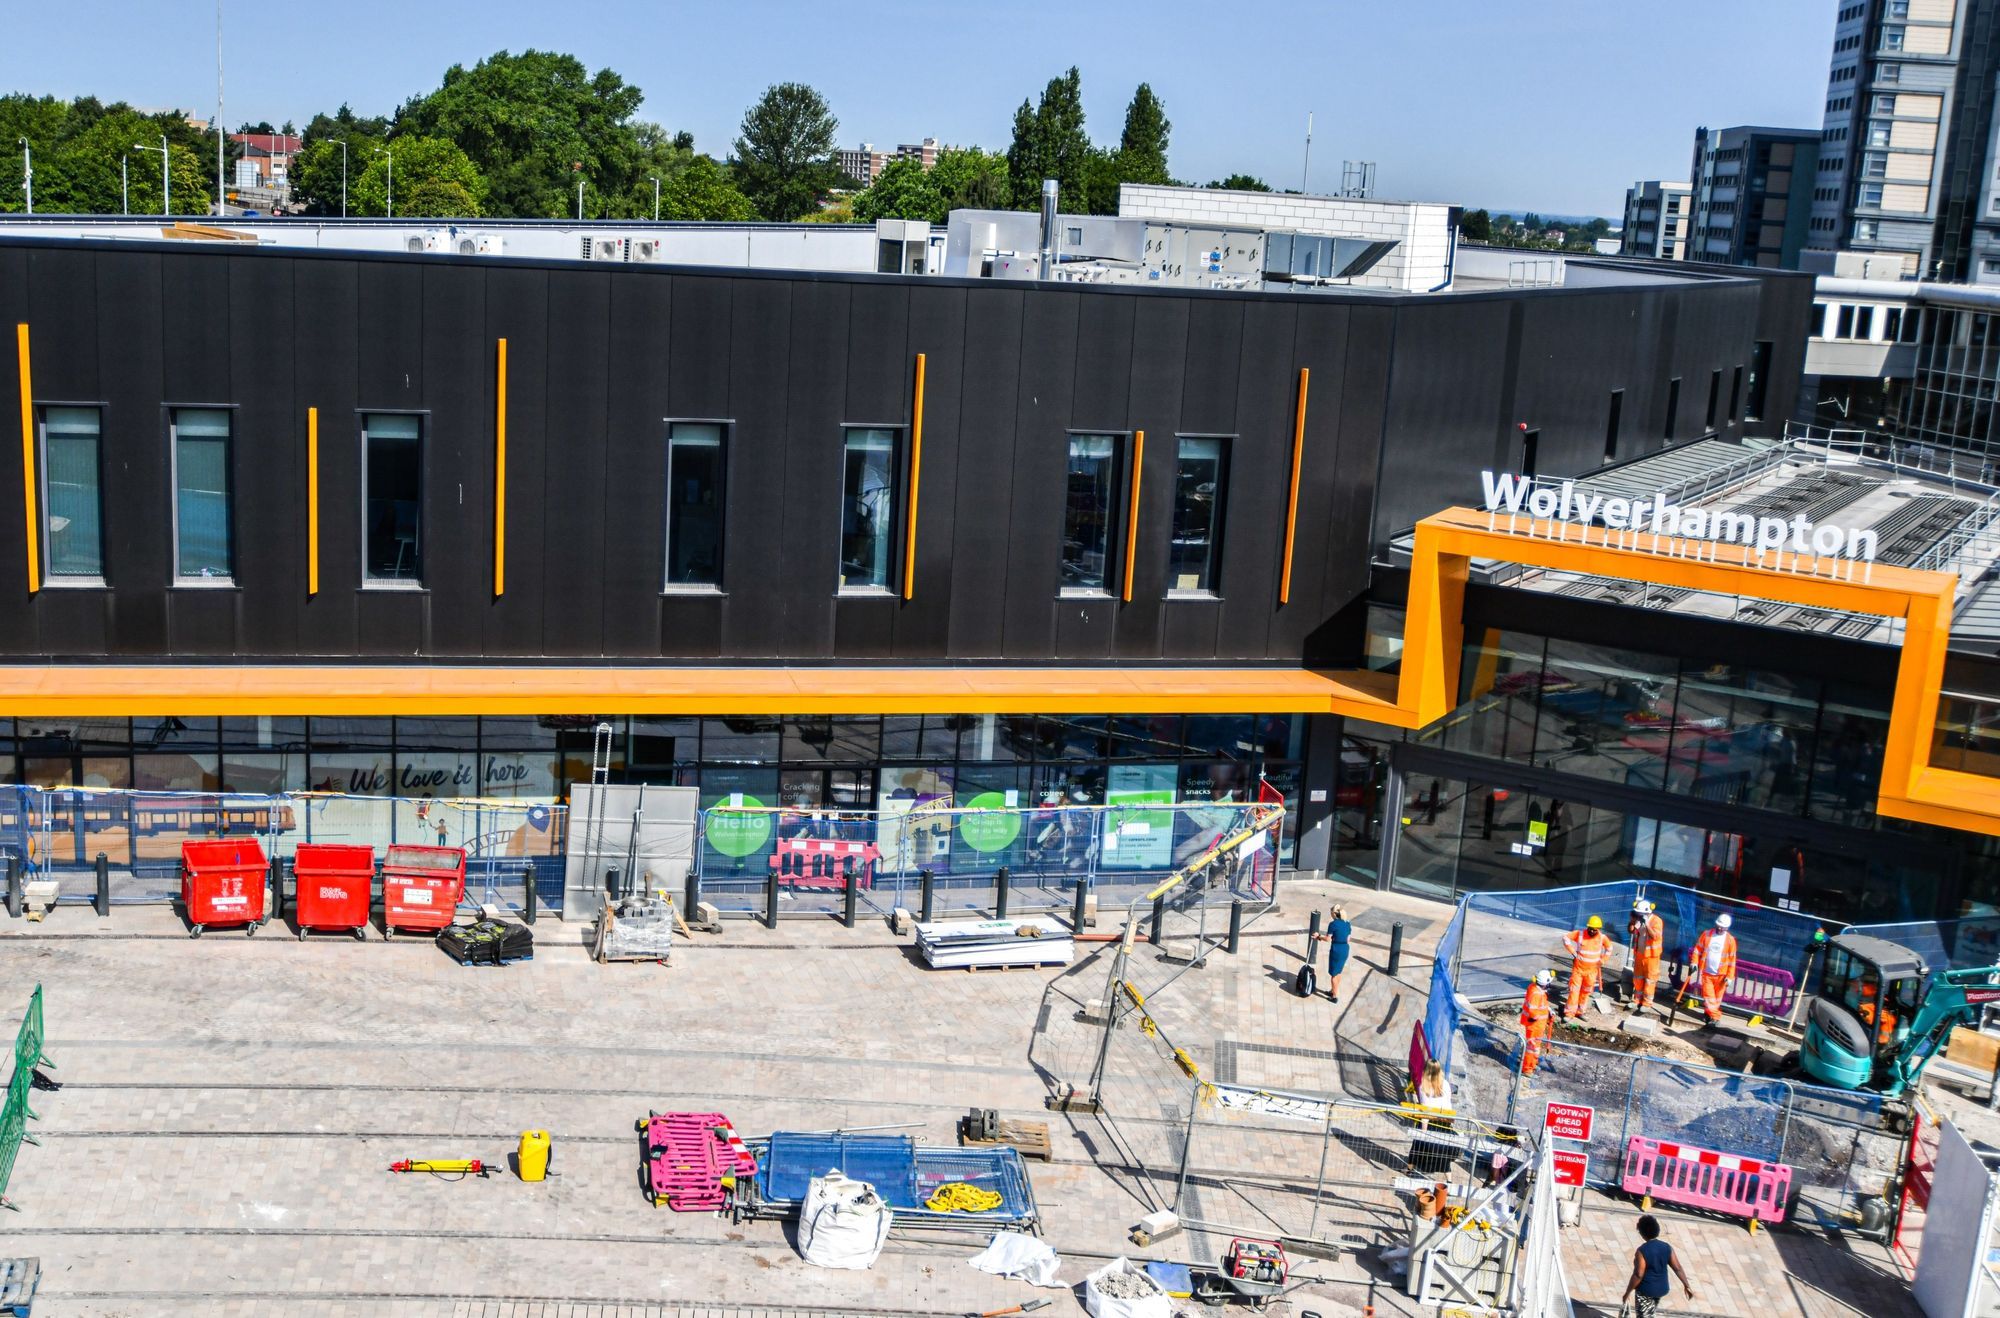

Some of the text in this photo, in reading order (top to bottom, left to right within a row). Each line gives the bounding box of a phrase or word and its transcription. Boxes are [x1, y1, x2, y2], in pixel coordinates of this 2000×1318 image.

[1482, 470, 1878, 560] Wolverhampton
[350, 756, 530, 792] We love it here
[783, 783, 820, 793] Cracking
[1187, 778, 1216, 788] Speedy
[1185, 788, 1211, 796] snacks
[713, 811, 765, 829] Hello
[1549, 1107, 1589, 1118] FOOTWAY
[1555, 1117, 1582, 1127] AHEAD
[1552, 1125, 1582, 1135] CLOSED
[1554, 1155, 1585, 1164] ESTRIANS
